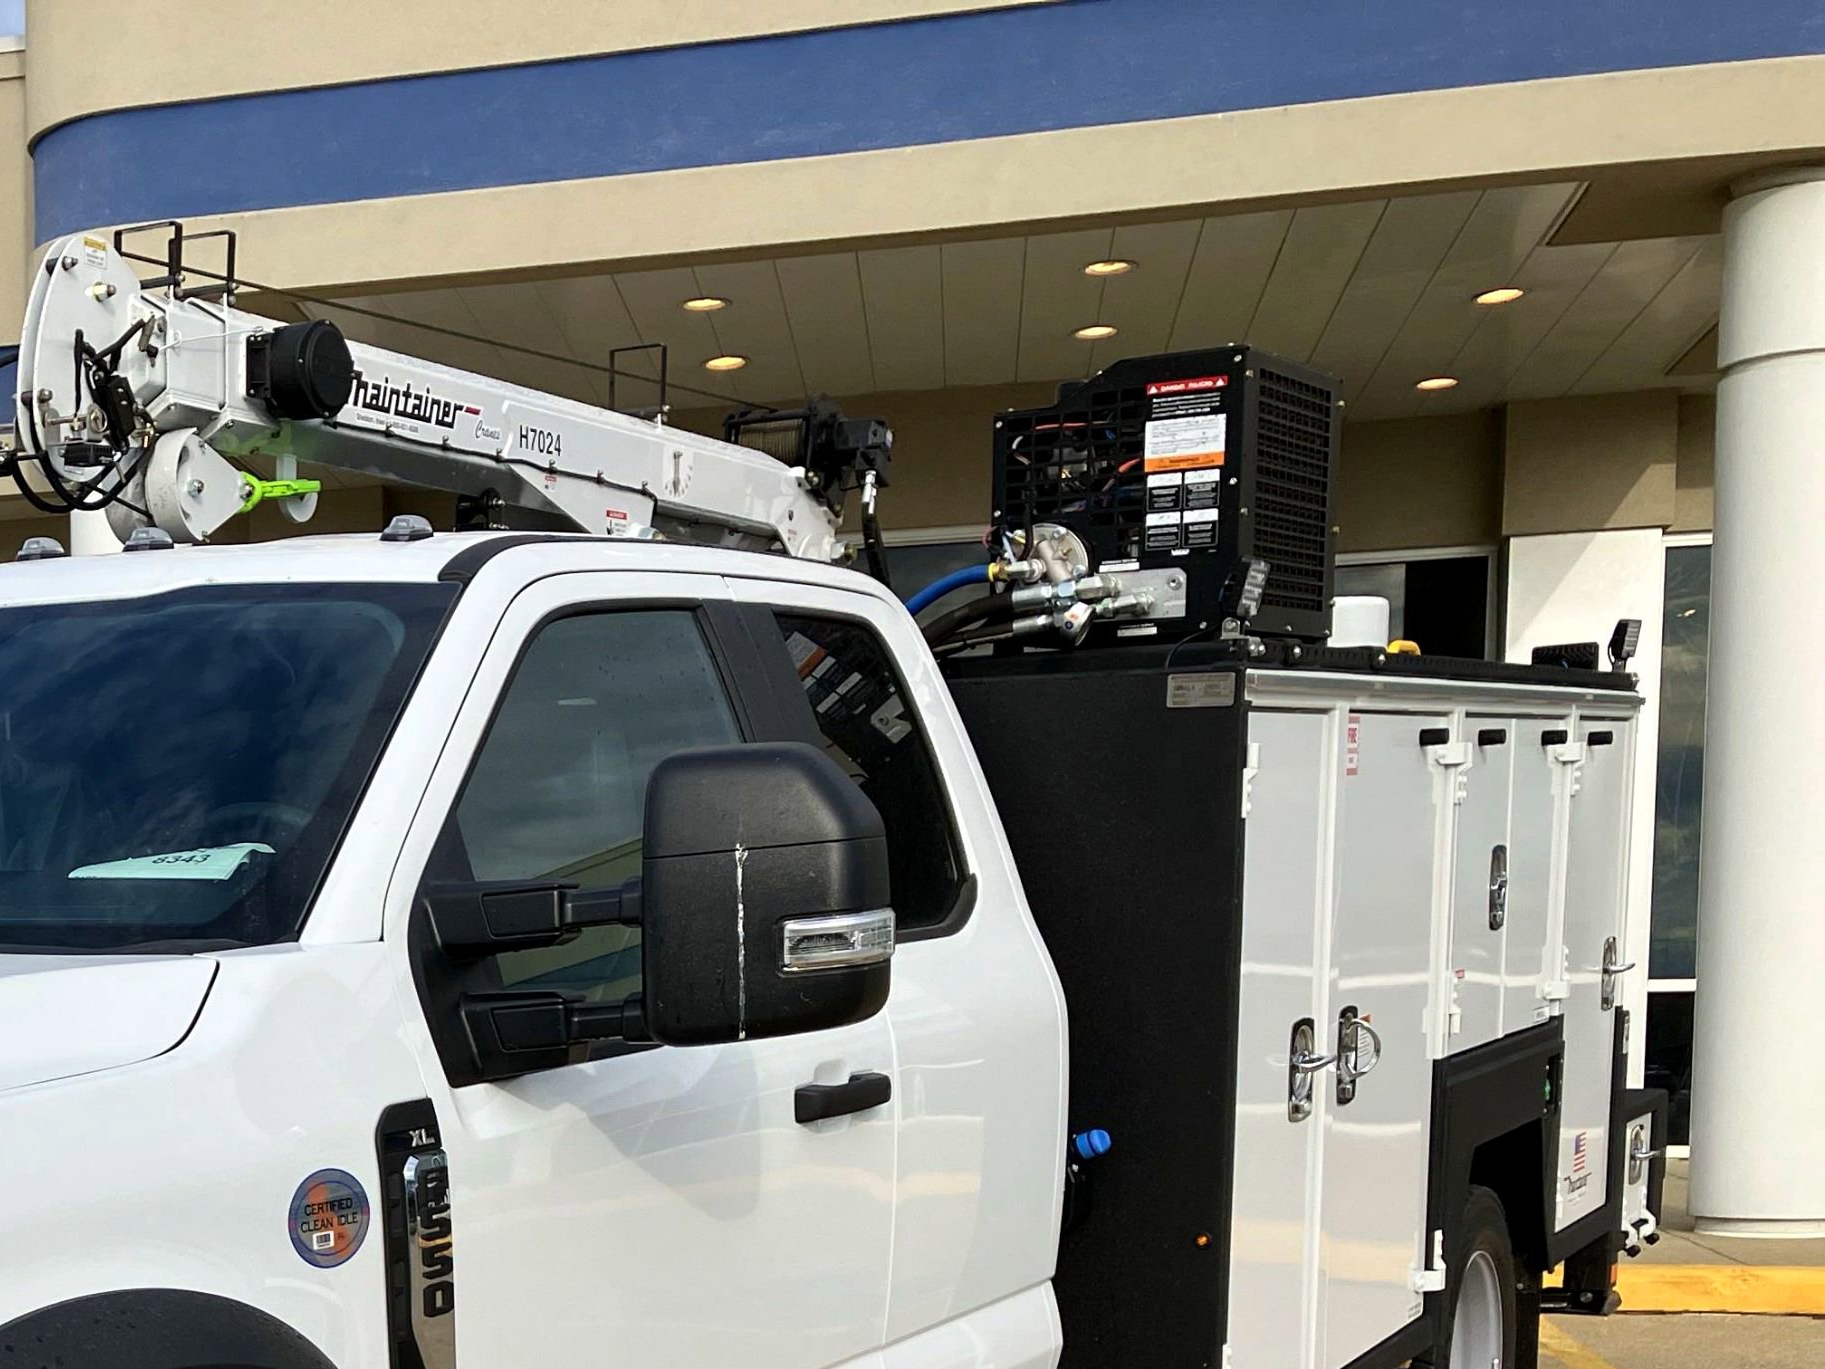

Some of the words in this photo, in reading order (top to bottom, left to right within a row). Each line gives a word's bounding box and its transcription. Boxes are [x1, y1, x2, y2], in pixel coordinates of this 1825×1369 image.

[519, 424, 562, 457] H7024
[152, 854, 211, 865] 8343
[409, 1128, 436, 1147] XL
[304, 1198, 353, 1216] CERTIFIED
[300, 1216, 334, 1233] CLEAN
[337, 1212, 358, 1226] IDLE
